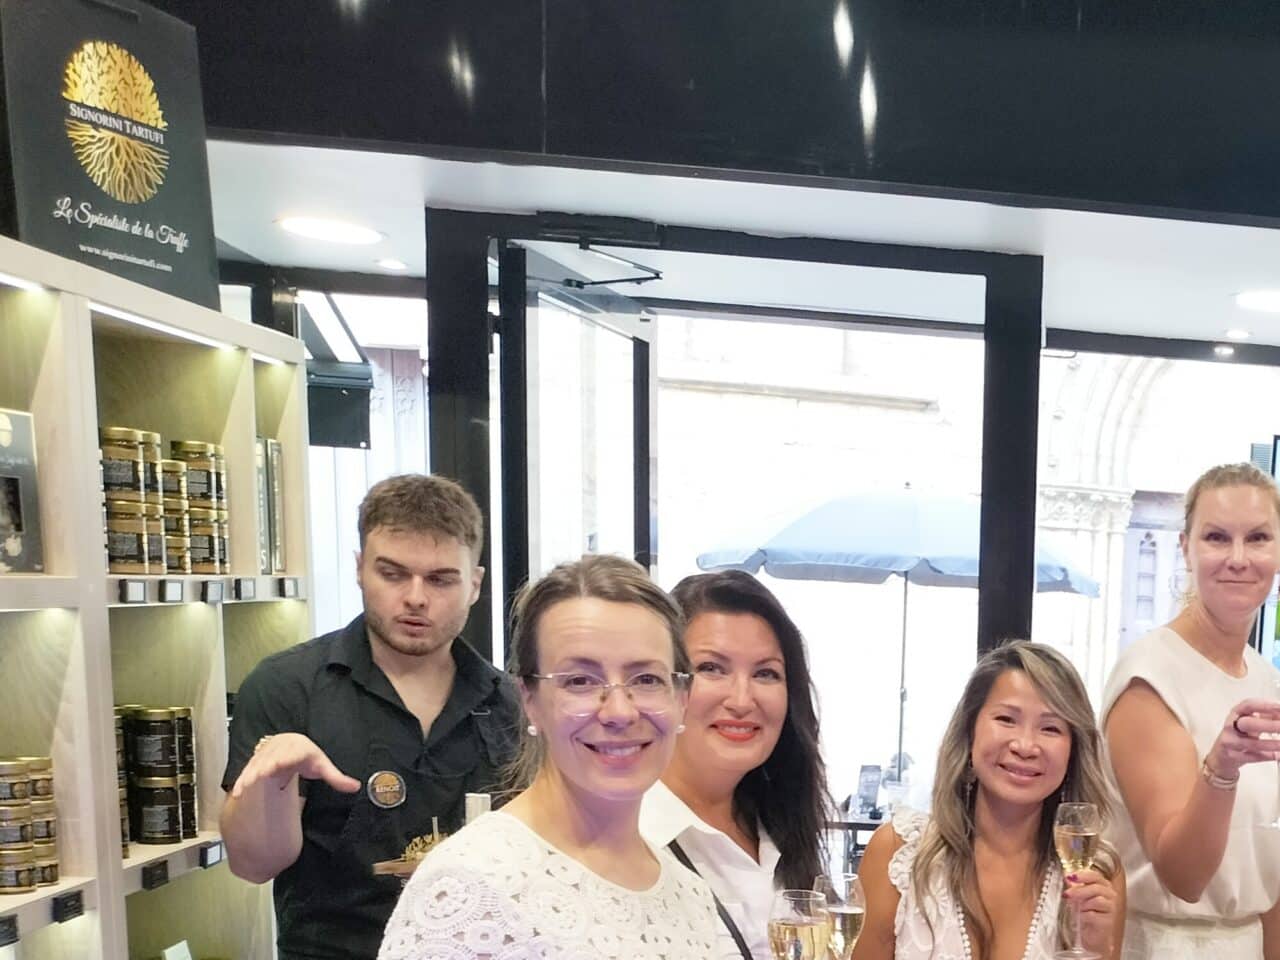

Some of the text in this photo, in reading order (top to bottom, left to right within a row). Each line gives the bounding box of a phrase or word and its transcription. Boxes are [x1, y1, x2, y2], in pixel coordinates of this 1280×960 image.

[69, 103, 164, 145] SIGNORINI TARTUFI
[53, 197, 74, 224] Le
[131, 221, 143, 236] de
[144, 223, 155, 240] la
[155, 224, 190, 254] Truffe
